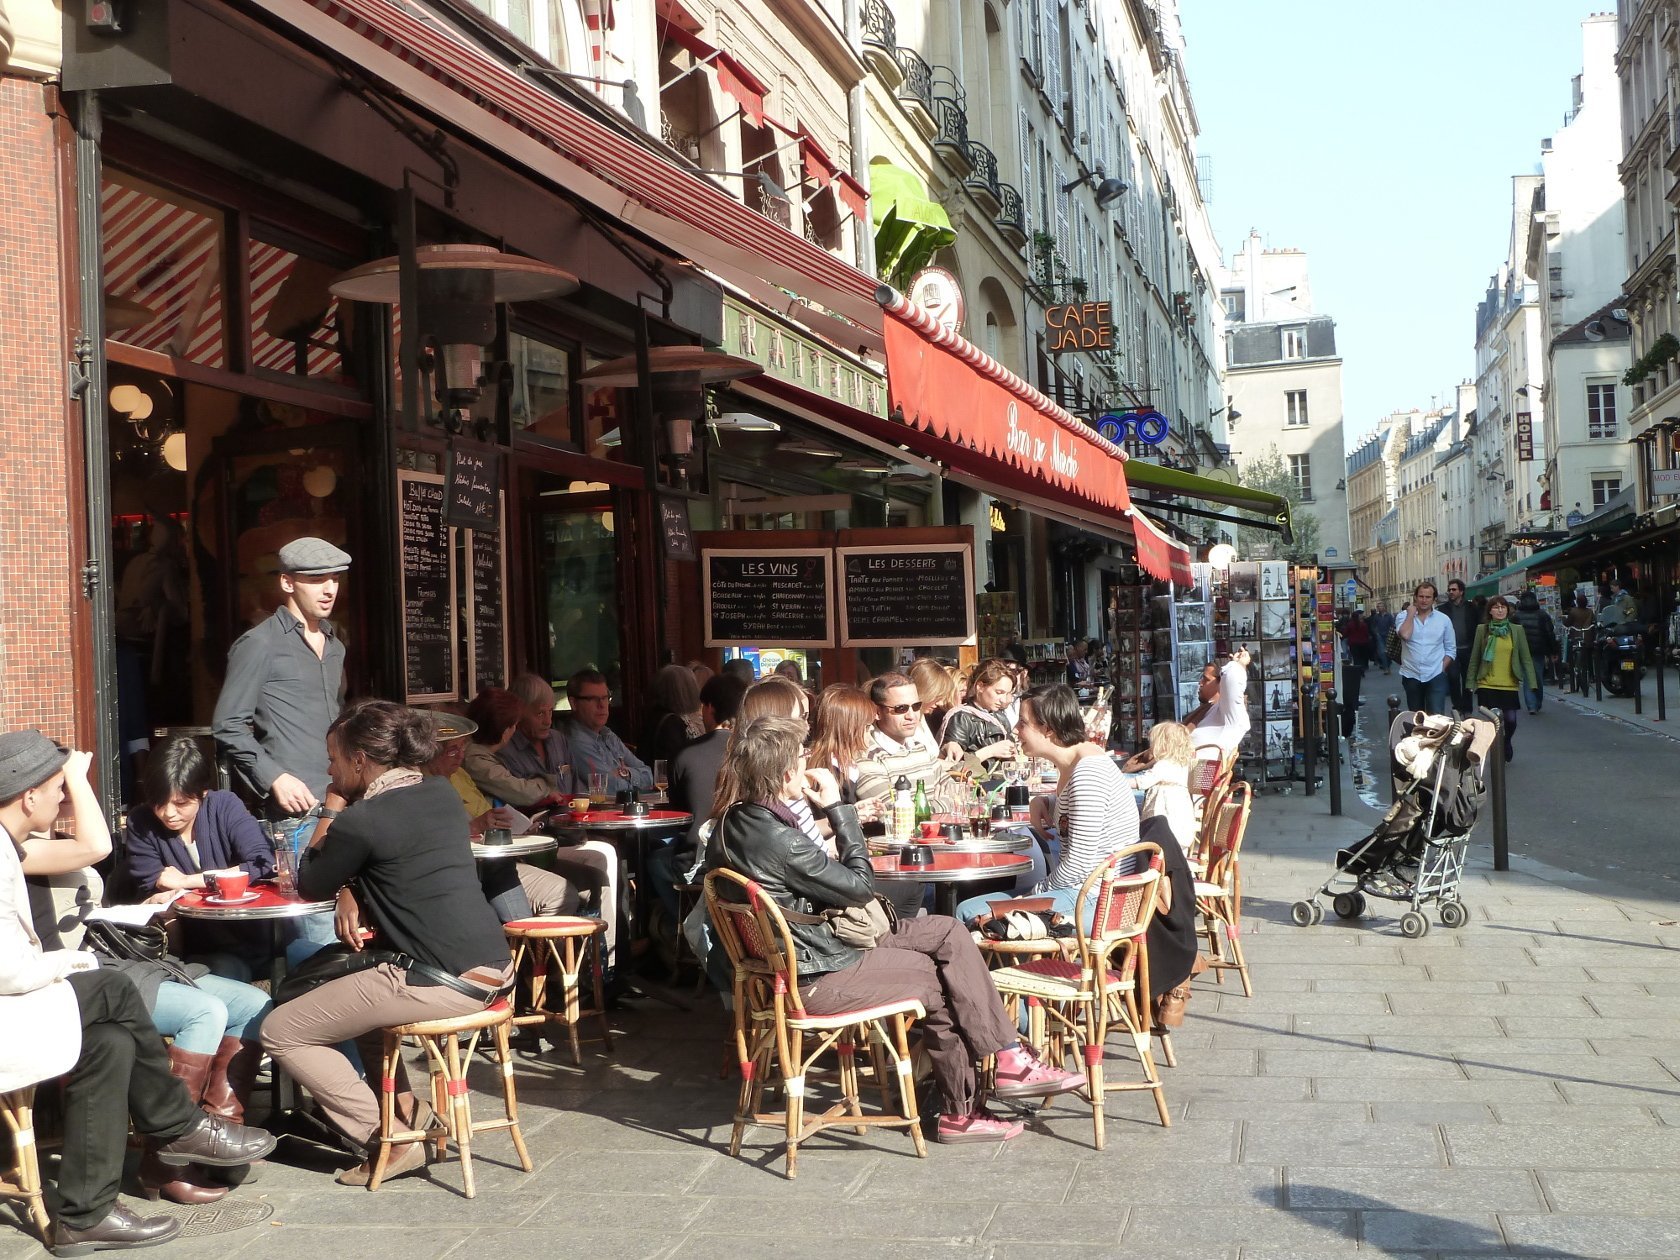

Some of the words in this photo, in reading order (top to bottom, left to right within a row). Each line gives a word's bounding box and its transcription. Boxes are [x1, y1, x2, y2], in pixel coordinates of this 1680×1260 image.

[1046, 303, 1110, 328] CAFE
[1050, 327, 1111, 350] JADE
[1518, 415, 1532, 460] HOTEL
[741, 563, 766, 575] LES
[770, 562, 799, 575] VINS
[868, 558, 886, 569] LES
[891, 558, 937, 569] DESSERTS
[848, 574, 870, 583] TARTE
[773, 581, 803, 589] MUSCADET
[720, 611, 746, 620] JOSEPH
[772, 611, 804, 620] SANCERRE
[872, 615, 904, 624] CARAMEL
